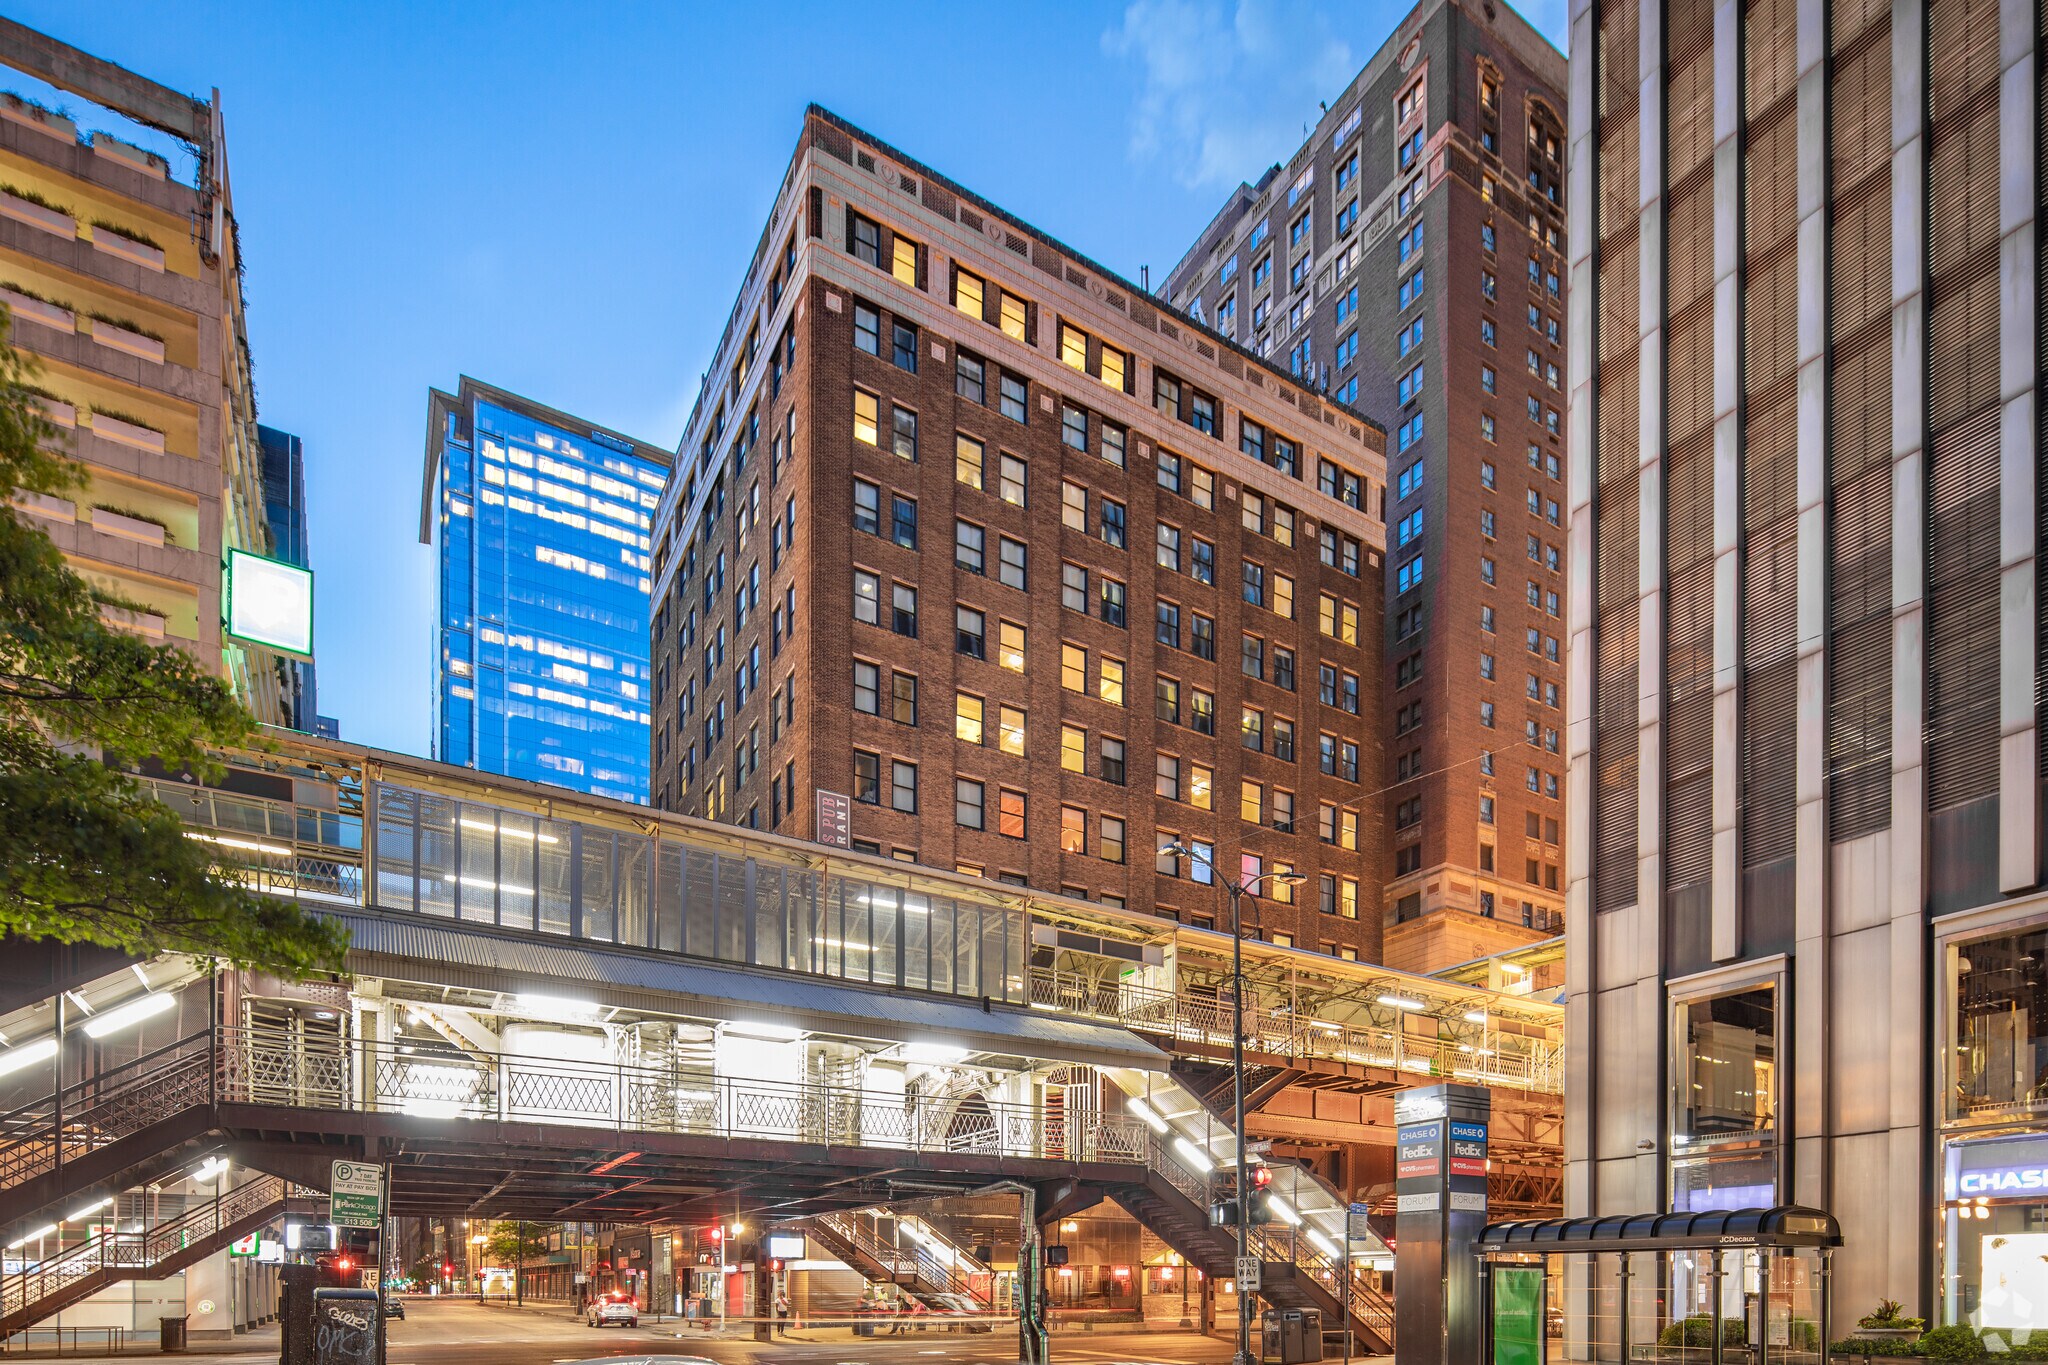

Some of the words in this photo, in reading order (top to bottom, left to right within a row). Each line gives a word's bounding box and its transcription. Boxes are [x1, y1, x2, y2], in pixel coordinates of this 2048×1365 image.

[836, 800, 846, 844] RANT
[1400, 1130, 1428, 1140] CHASE
[1453, 1127, 1476, 1136] CHASE
[1402, 1145, 1433, 1158] FedEx
[1455, 1142, 1481, 1156] FedEx
[1401, 1196, 1430, 1206] FORUM
[1454, 1195, 1478, 1204] FORUM
[364, 1272, 377, 1280] NE
